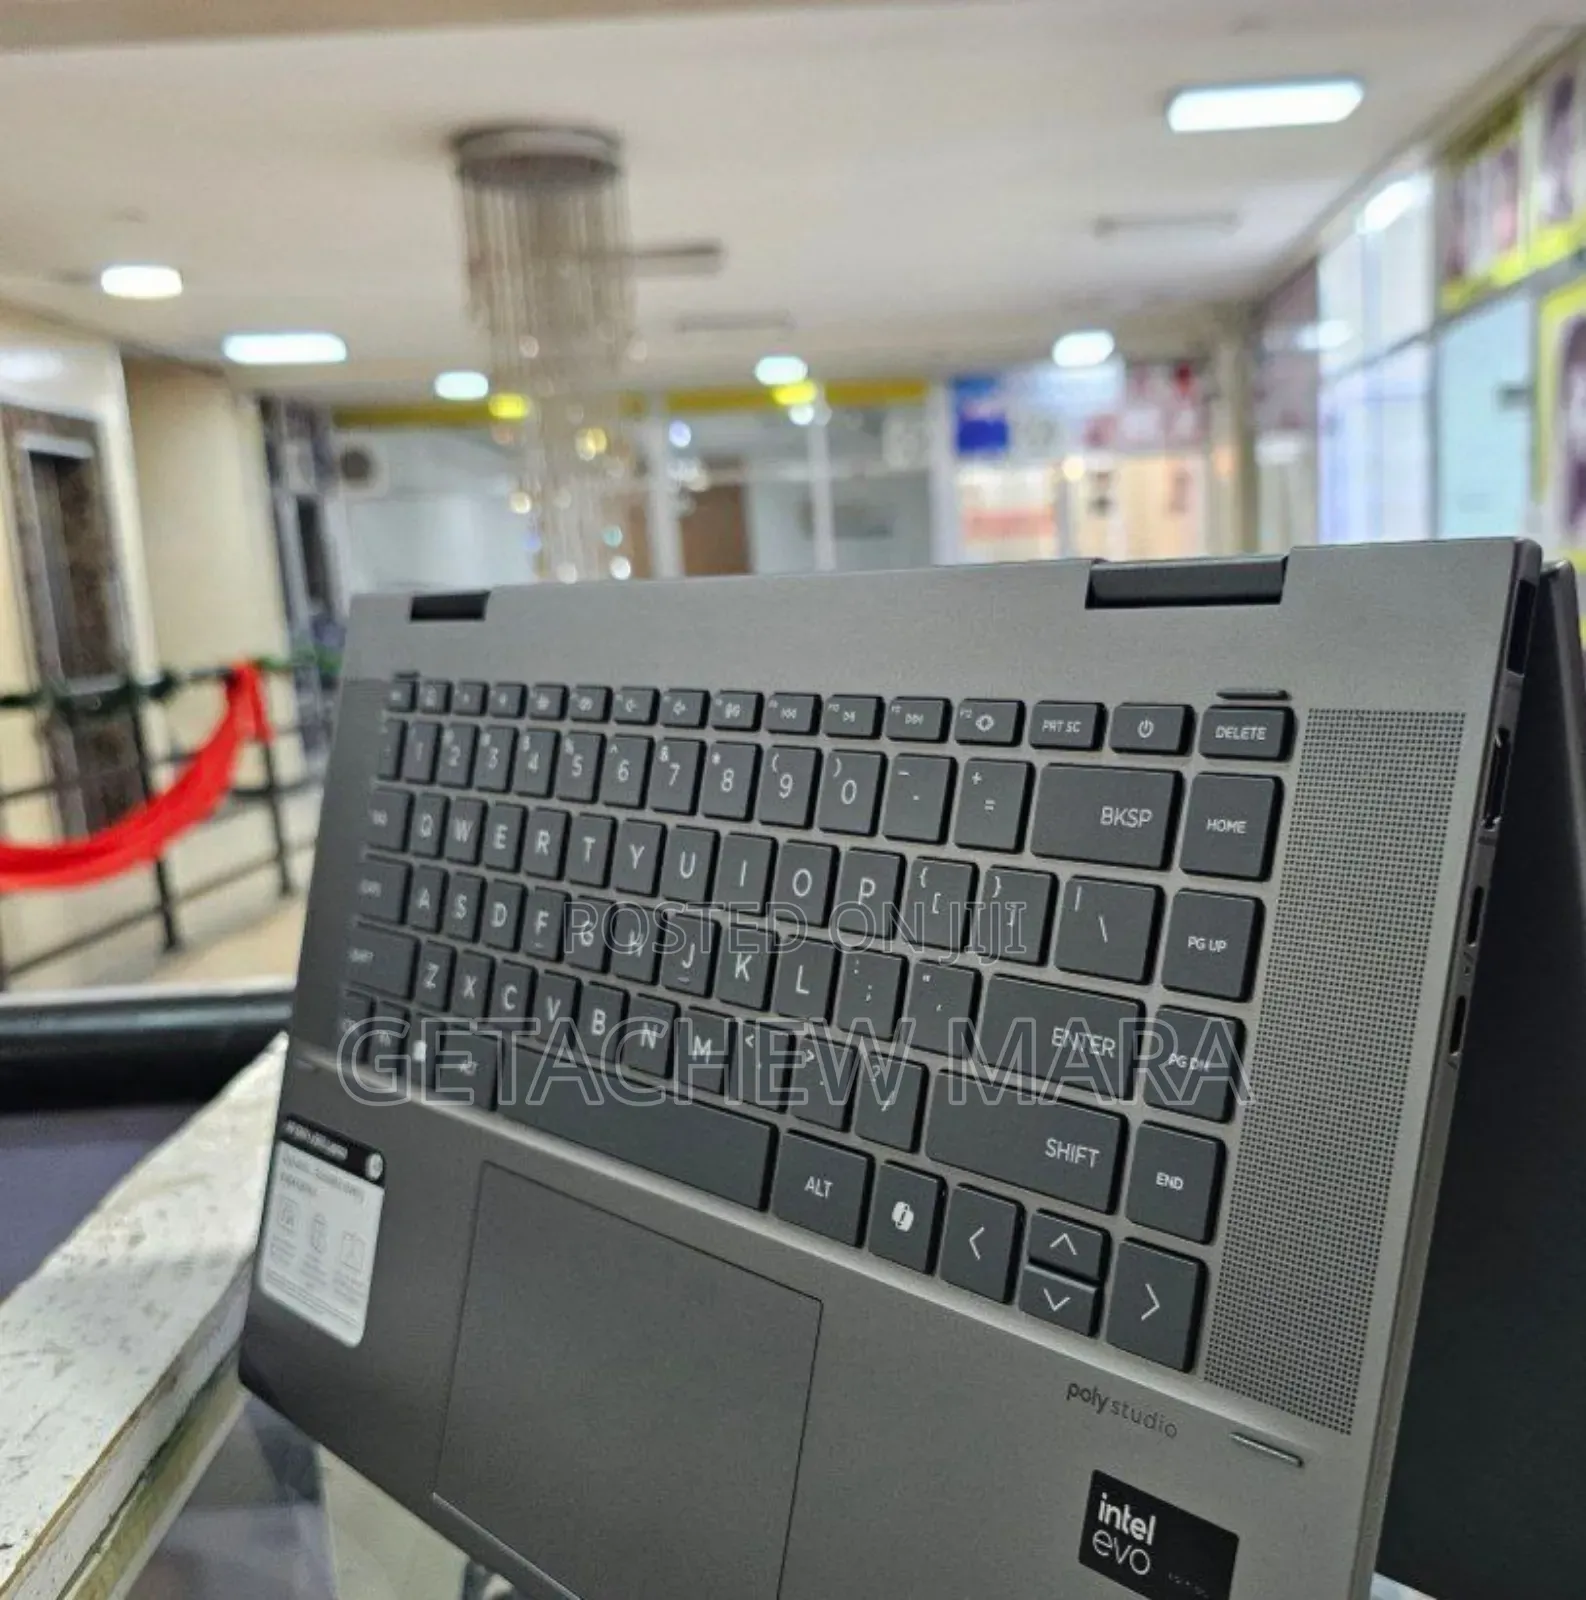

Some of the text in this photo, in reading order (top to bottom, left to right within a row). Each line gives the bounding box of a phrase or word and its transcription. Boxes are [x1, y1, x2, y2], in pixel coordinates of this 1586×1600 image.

[1042, 719, 1082, 734] PRT SC
[1215, 725, 1267, 740] DELETE
[527, 752, 540, 773] 4
[571, 754, 584, 778] 5
[617, 758, 630, 783] 6
[668, 762, 681, 787] 7
[720, 768, 735, 793] 8
[779, 773, 794, 799] 9
[1100, 805, 1153, 829] BKSP
[1206, 818, 1248, 834] HOME
[454, 818, 474, 843] W
[493, 824, 507, 850] E
[536, 829, 551, 855] R
[582, 836, 596, 863] T
[629, 844, 645, 869] Y
[679, 851, 696, 879] U
[739, 859, 748, 888] I
[791, 868, 813, 898] O
[857, 877, 876, 905] P
[417, 887, 431, 910] A
[453, 893, 468, 921] S
[490, 902, 508, 929] D
[534, 910, 550, 936] F
[681, 943, 696, 970] J
[1187, 935, 1228, 953] PG UP
[422, 962, 440, 990] Z
[734, 951, 752, 983] K
[795, 964, 810, 995] L
[462, 974, 478, 1000] X
[502, 984, 518, 1011] C
[547, 996, 561, 1021] V
[591, 1007, 606, 1037] B
[639, 1021, 660, 1050] N
[1051, 1025, 1116, 1059] ENTER
[691, 1034, 713, 1065] M
[1168, 1052, 1188, 1069] PG
[1045, 1137, 1100, 1170] SHIFT
[804, 1175, 834, 1200] ALT
[1155, 1171, 1184, 1191] END
[1066, 1382, 1178, 1439] poly studio
[1097, 1491, 1156, 1546] intel
[1092, 1529, 1151, 1576] evo
